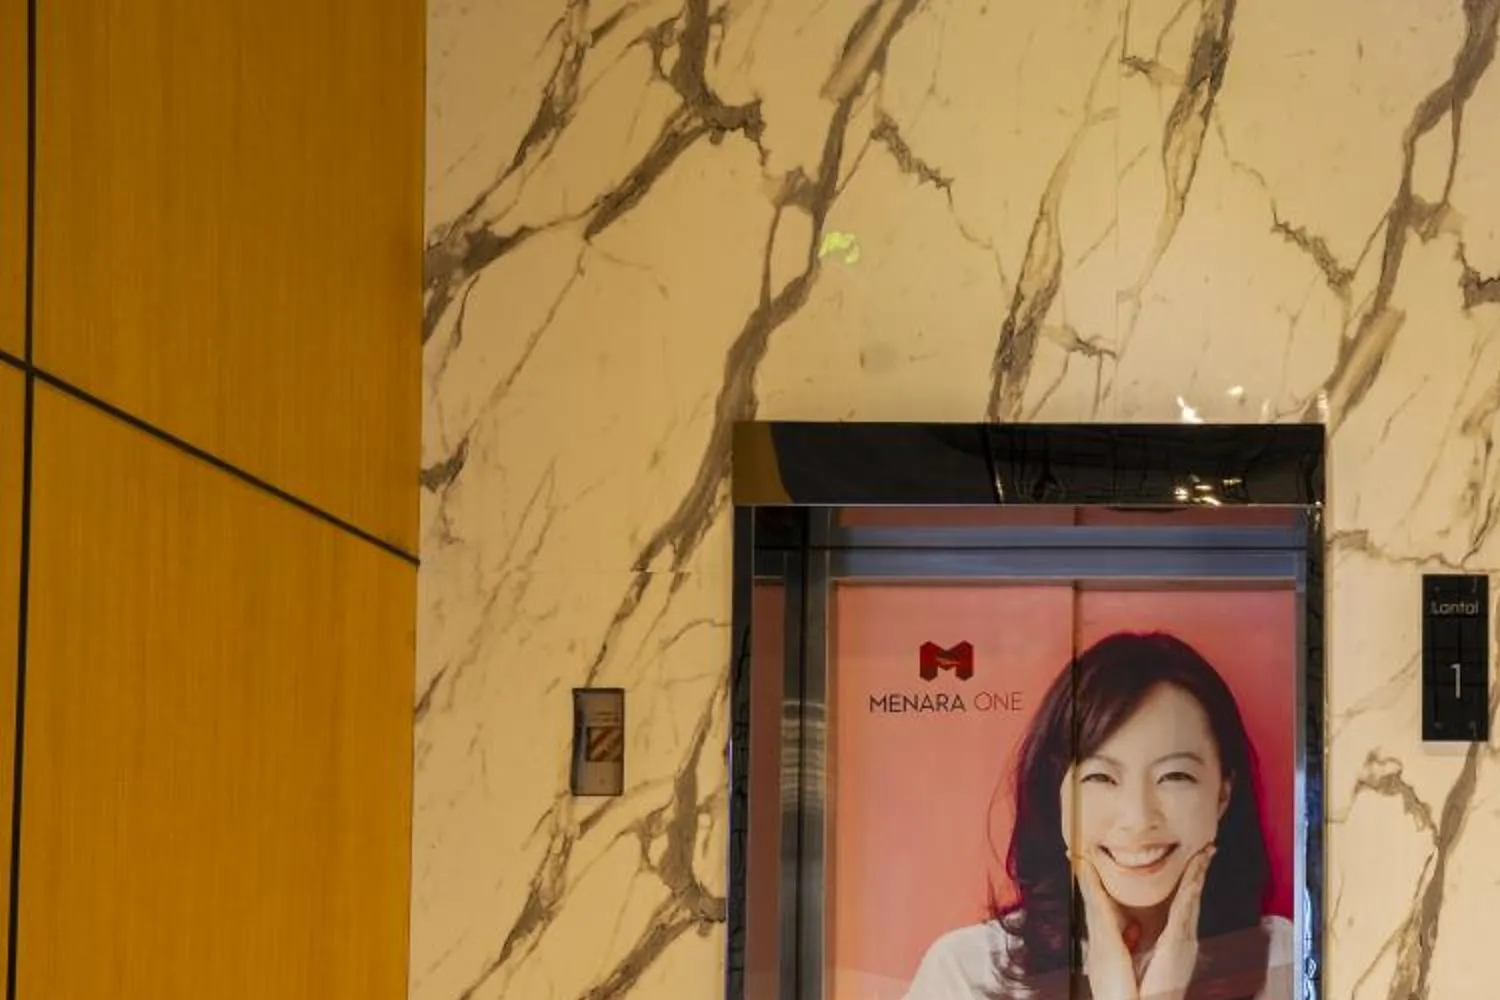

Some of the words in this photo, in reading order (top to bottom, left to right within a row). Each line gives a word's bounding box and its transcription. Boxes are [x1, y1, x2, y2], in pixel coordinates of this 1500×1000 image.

[1431, 602, 1479, 615] Lantai
[1450, 663, 1461, 699] 1
[869, 693, 966, 713] MENARA
[973, 691, 1024, 711] ONE
